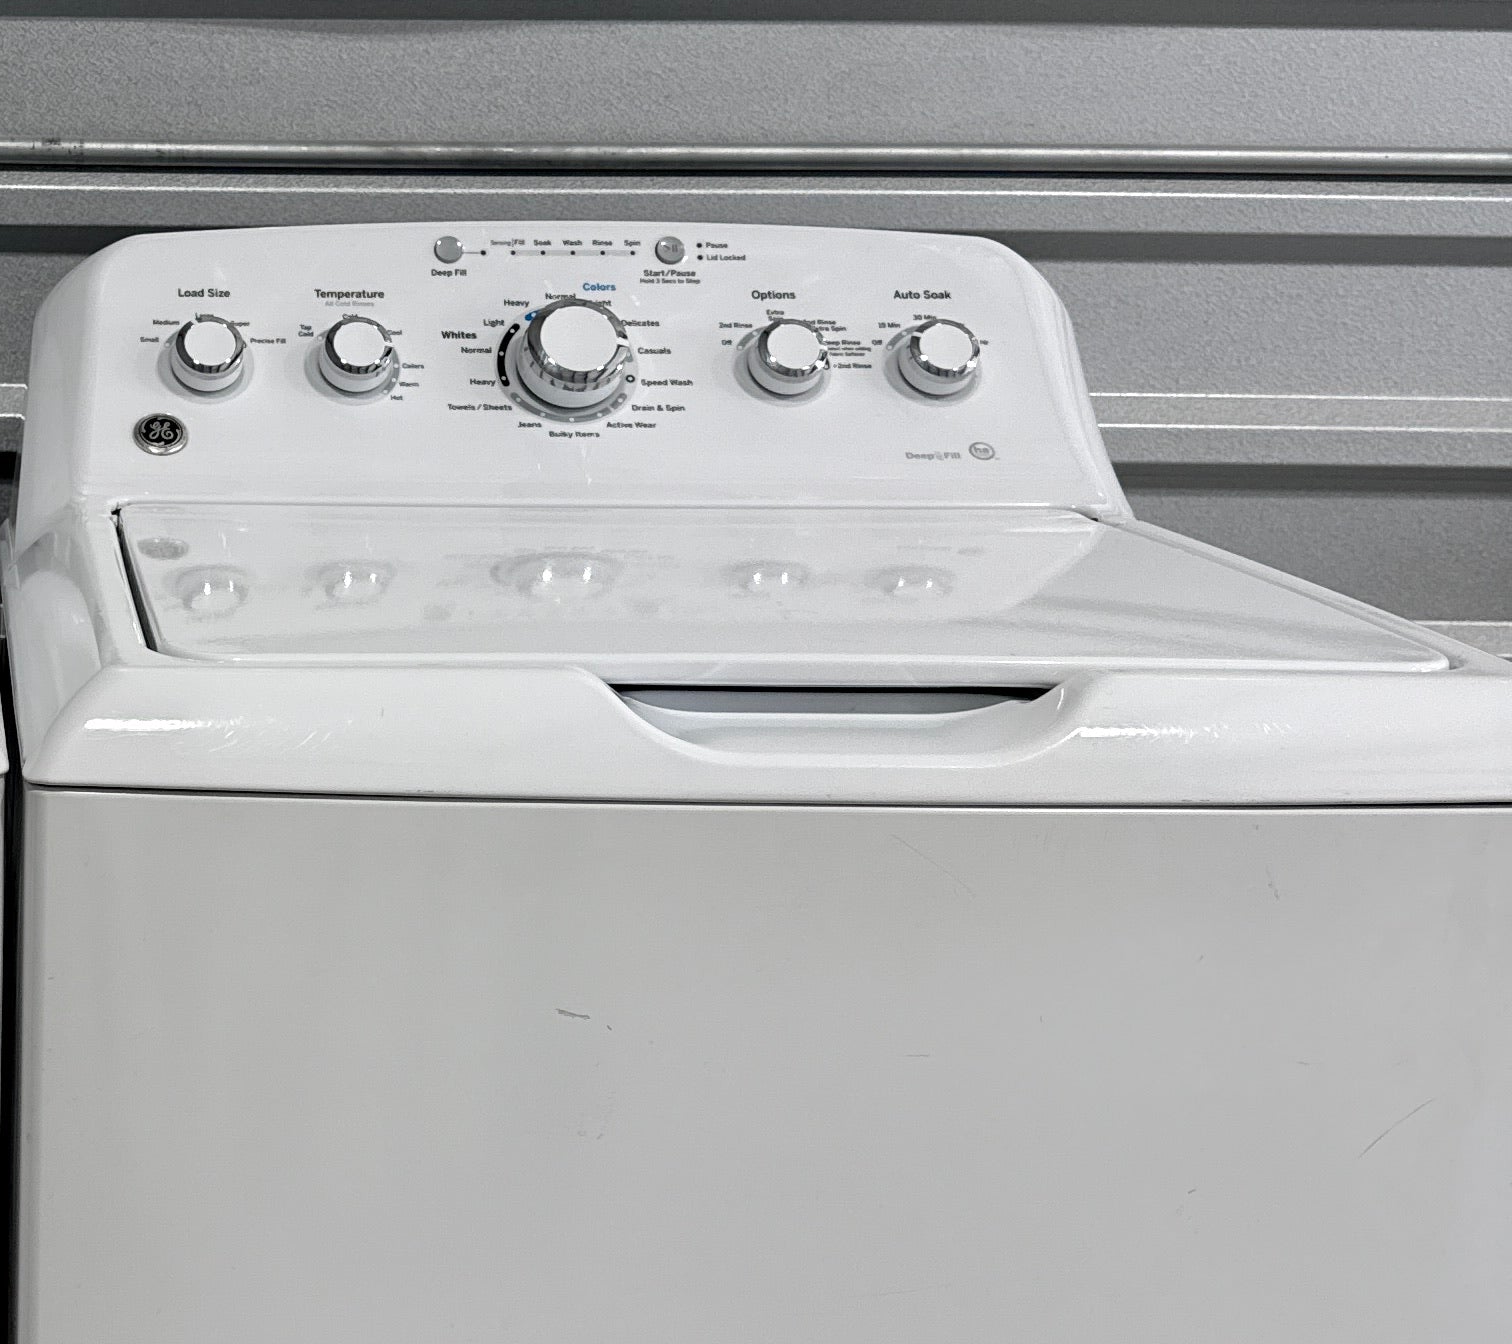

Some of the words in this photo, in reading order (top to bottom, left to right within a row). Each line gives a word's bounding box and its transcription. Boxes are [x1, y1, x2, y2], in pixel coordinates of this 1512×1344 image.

[431, 269, 453, 277] Deep
[582, 283, 616, 291] Colors
[178, 289, 205, 297] Load
[208, 288, 231, 298] Size
[314, 289, 385, 300] Temperature
[751, 290, 796, 301] Options
[894, 290, 921, 299] Auto
[923, 290, 952, 299] Soak
[504, 299, 530, 308] Heavy
[483, 319, 505, 328] Light
[441, 331, 477, 339] Whites
[470, 379, 496, 387] Heavy
[641, 379, 668, 387] Speed
